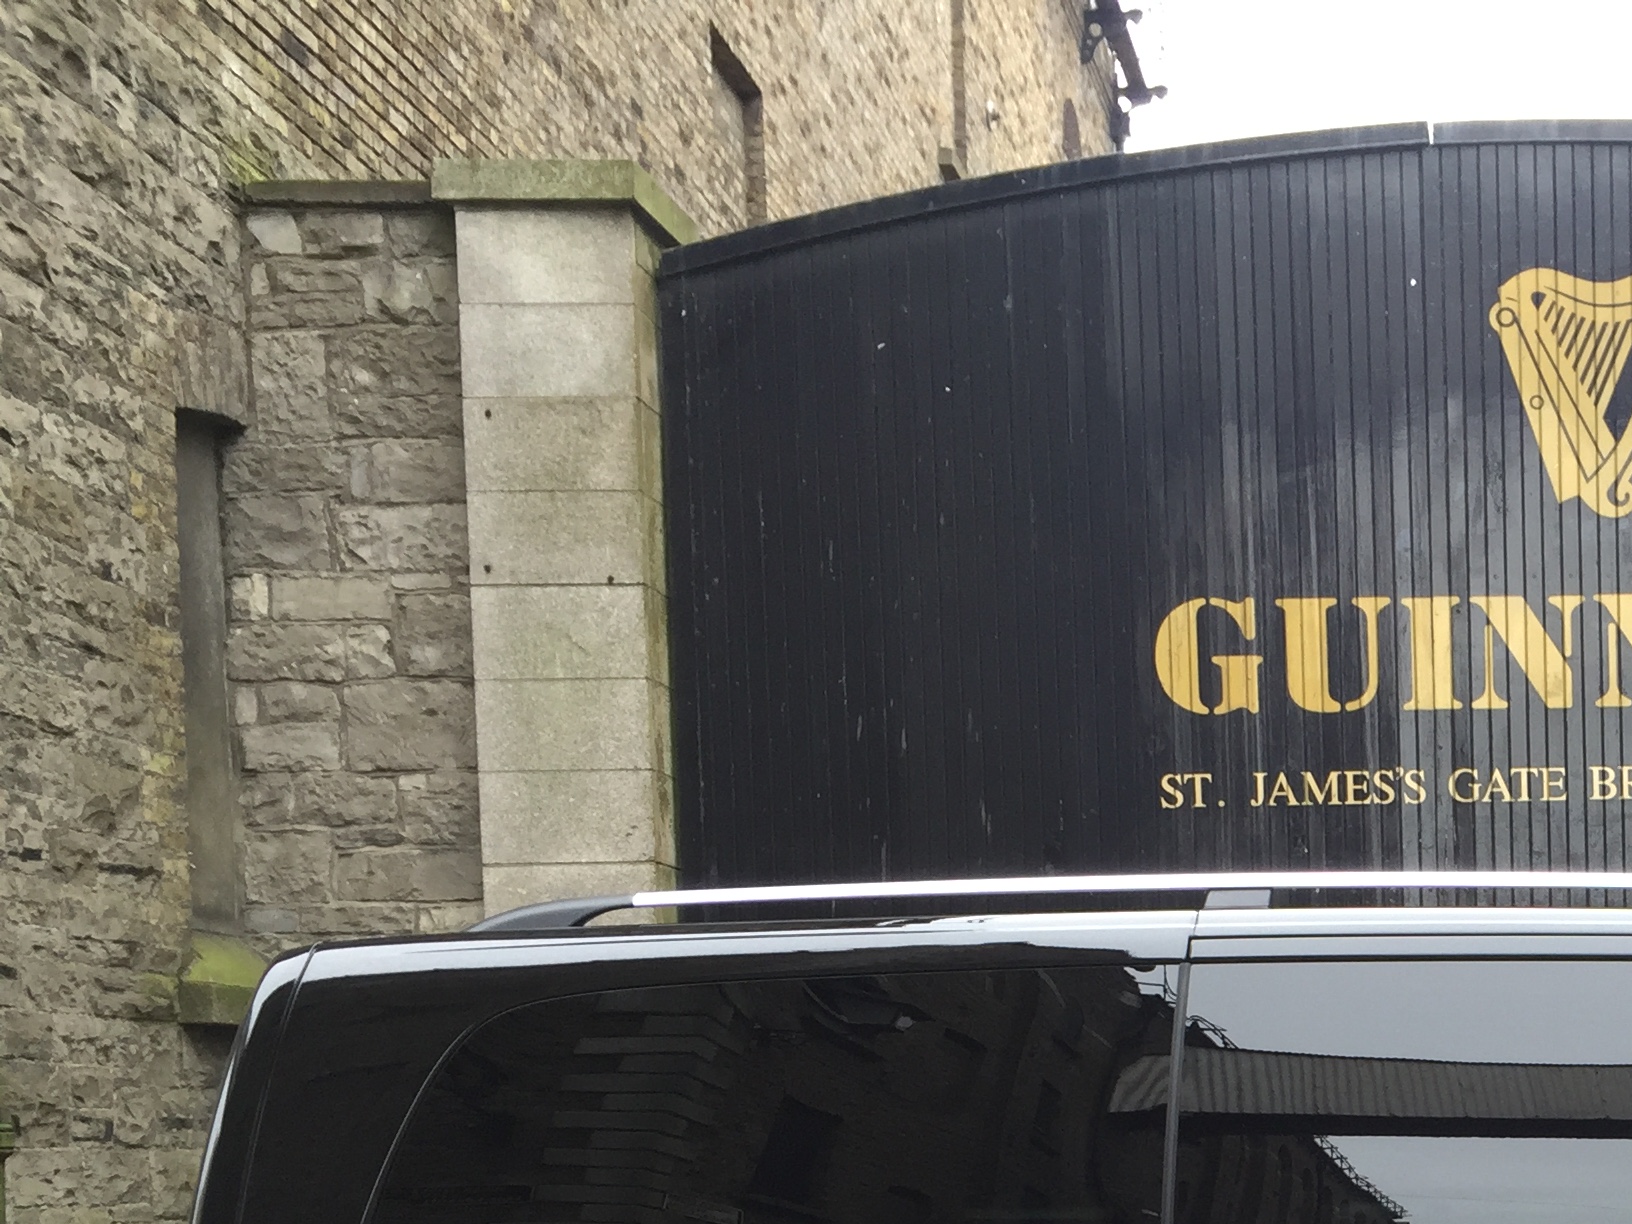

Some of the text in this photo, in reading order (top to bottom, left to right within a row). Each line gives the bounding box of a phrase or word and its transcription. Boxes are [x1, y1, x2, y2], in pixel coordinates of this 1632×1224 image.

[1160, 772, 1225, 809] ST.
[1250, 766, 1427, 807] JAMES'S
[1447, 765, 1568, 802] GATE
